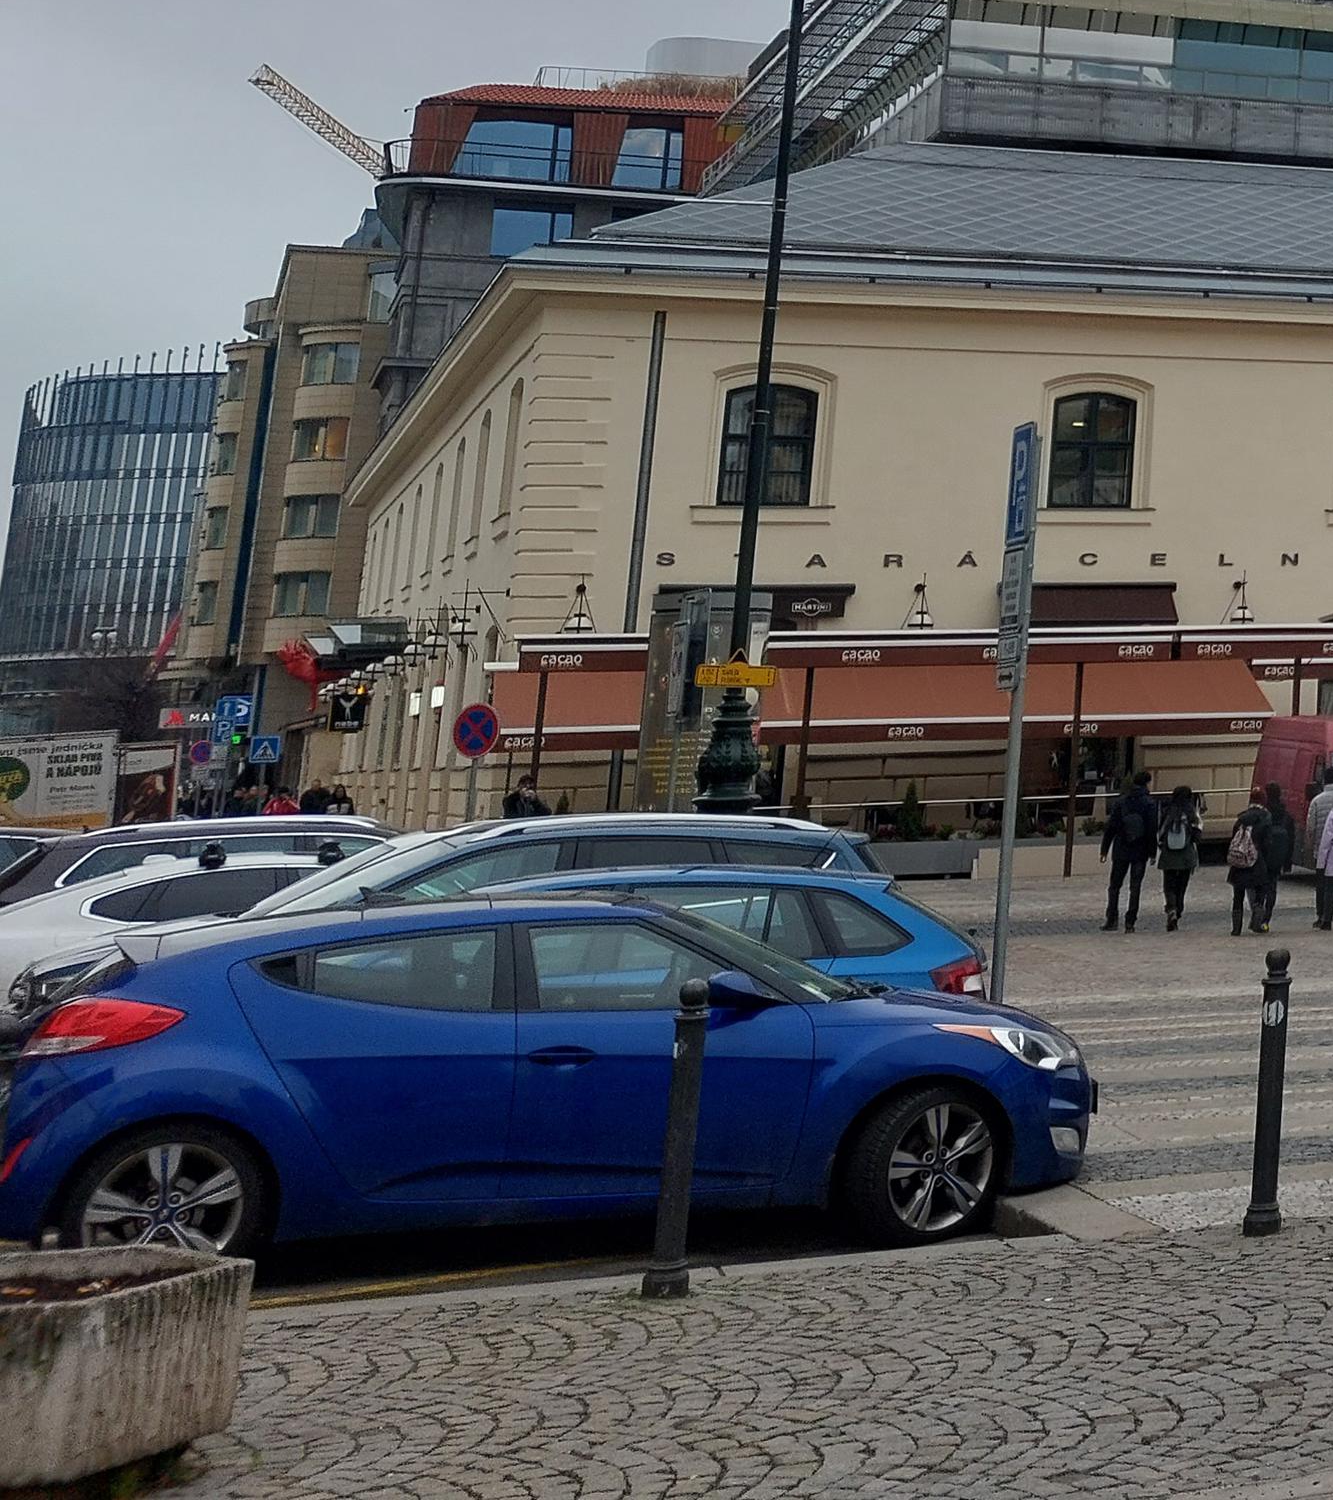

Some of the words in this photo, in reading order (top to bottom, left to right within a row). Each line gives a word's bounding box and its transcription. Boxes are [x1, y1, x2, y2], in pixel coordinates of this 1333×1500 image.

[656, 550, 978, 567] SARÁ
[794, 603, 829, 611] MARTINI
[1118, 644, 1154, 656] cacao
[1197, 643, 1232, 655] cacao
[541, 653, 583, 666] cacao
[842, 649, 880, 662] cacao
[888, 725, 924, 737] cacao
[1230, 719, 1263, 731] cacao
[504, 737, 545, 748] caca
